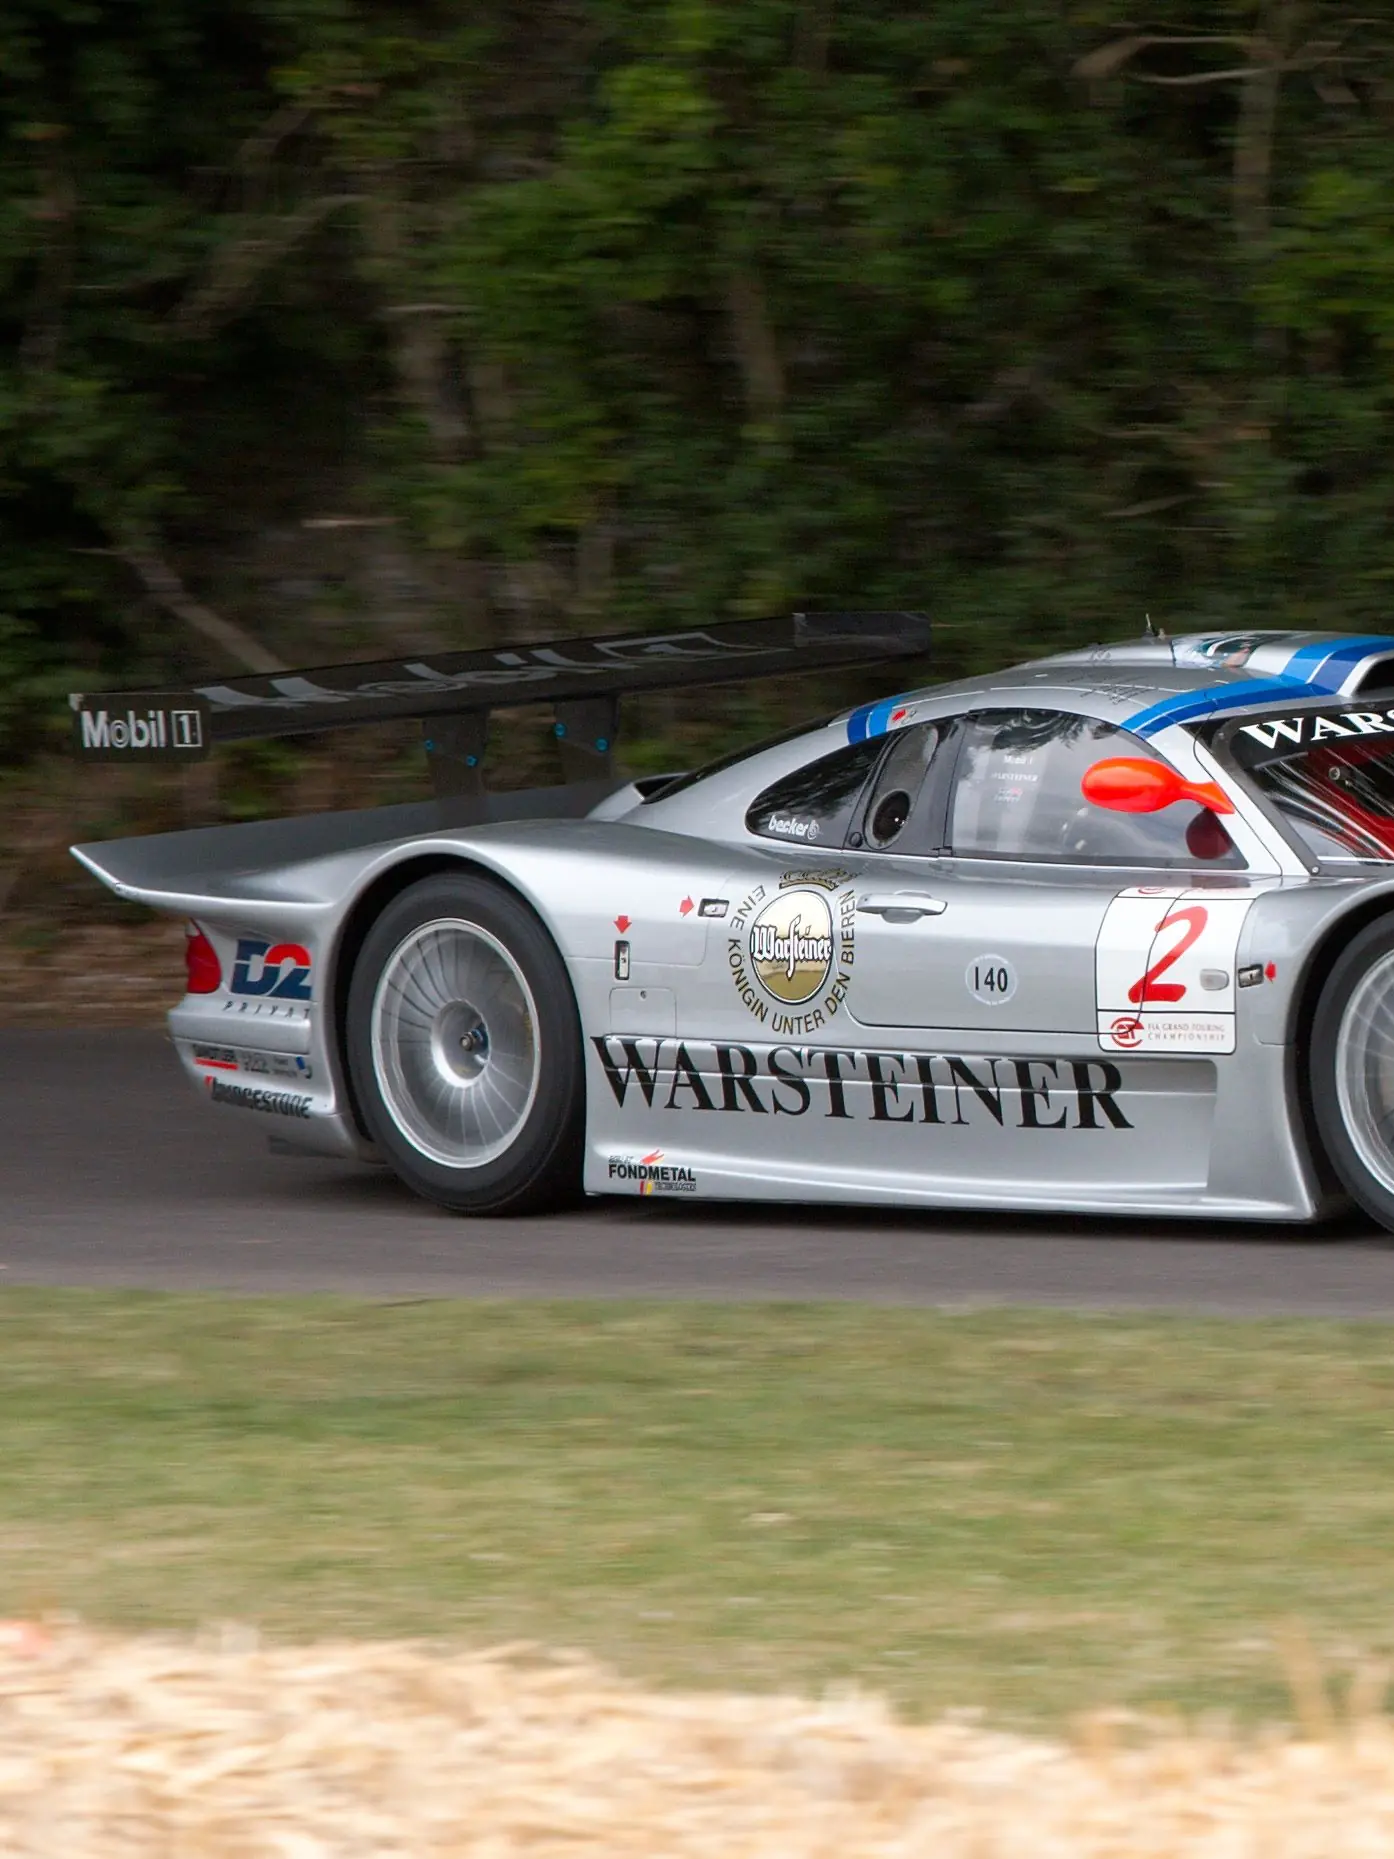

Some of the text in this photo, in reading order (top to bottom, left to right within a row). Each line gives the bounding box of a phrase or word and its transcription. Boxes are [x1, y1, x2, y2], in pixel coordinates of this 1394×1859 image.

[81, 710, 166, 748] Mobil
[768, 815, 808, 836] becker
[231, 939, 311, 1001] D2
[728, 884, 856, 1035] EINE KÖNIGIN UNTER DEN BIEREN
[1128, 906, 1208, 1003] 2
[974, 966, 1008, 993] 140
[223, 1000, 311, 1020] PRIVAT
[590, 1035, 1134, 1129] WARSTEINER
[608, 1163, 697, 1182] FONDMETAL
